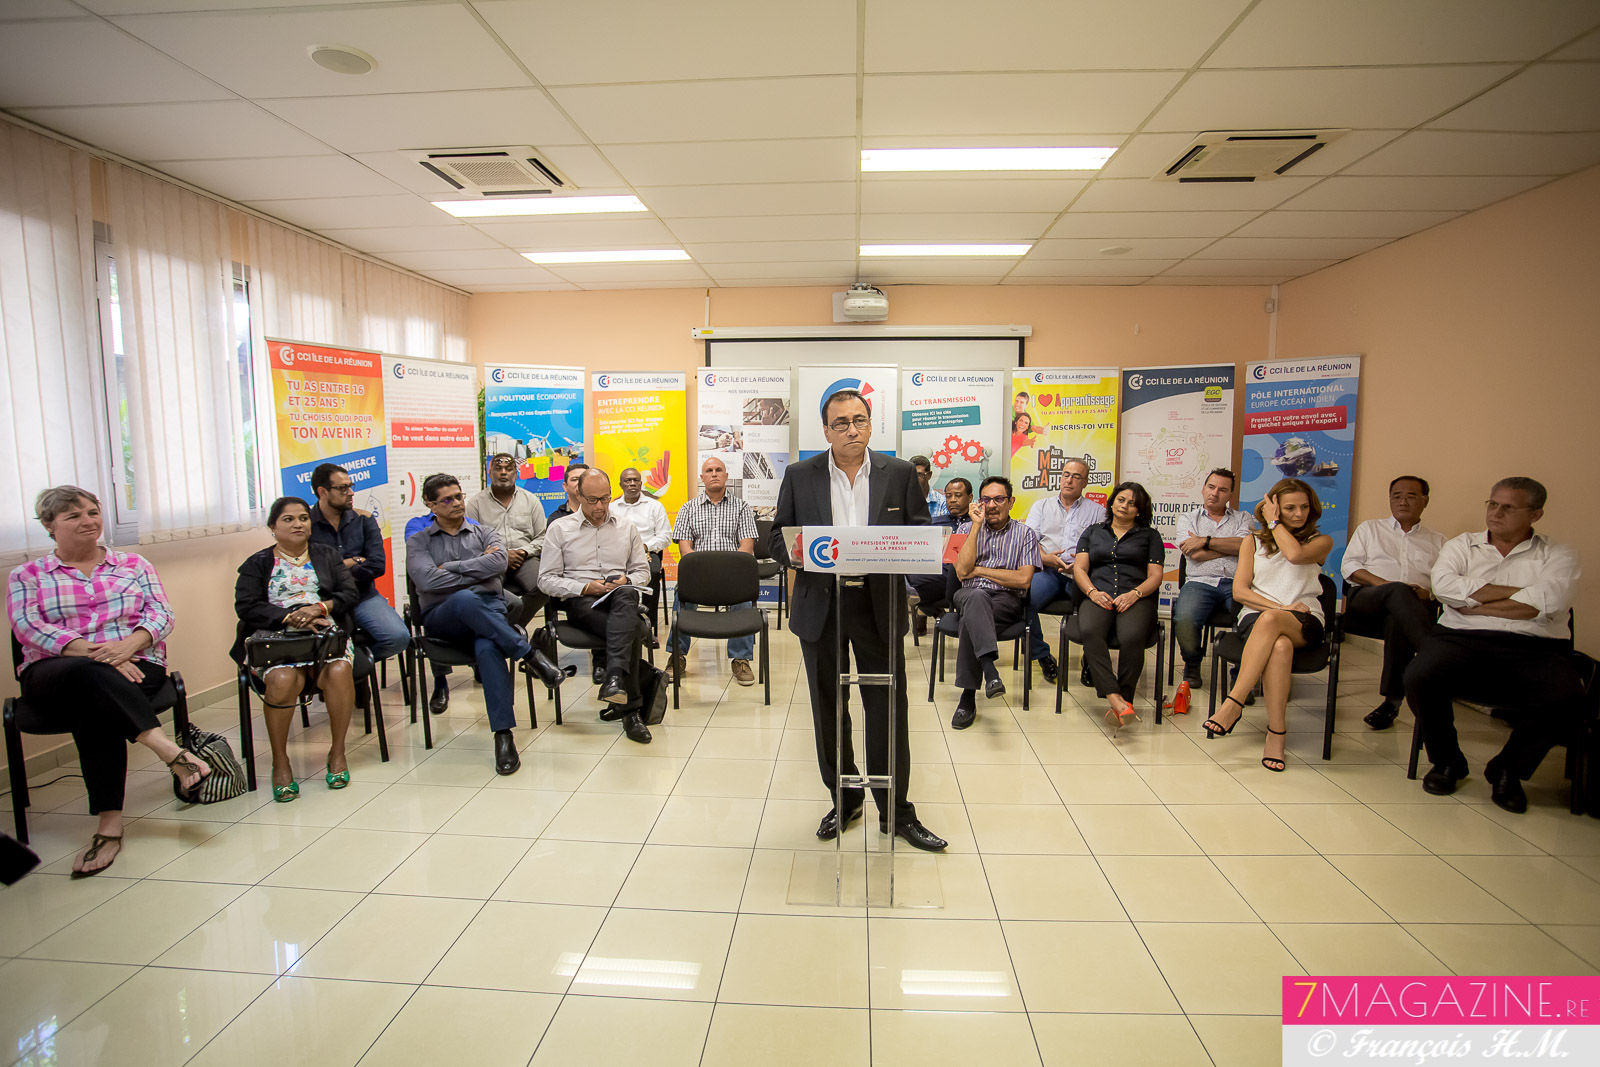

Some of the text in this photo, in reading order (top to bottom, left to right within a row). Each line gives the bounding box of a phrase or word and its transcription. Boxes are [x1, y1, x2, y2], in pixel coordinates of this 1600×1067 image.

[297, 352, 310, 360] CCI
[312, 353, 322, 362] ÎLE
[344, 358, 372, 368] RÉUNION
[287, 380, 364, 394] TU AS ENTRE 16
[1251, 384, 1345, 400] PÔLE INTERNATIONAL
[289, 396, 338, 407] ET 25 ANS
[597, 395, 660, 407] ENTREPRENDRE
[924, 396, 976, 404] TRANSMISSION
[1055, 393, 1115, 409] Apprentissage
[1251, 400, 1278, 408] EUROPE
[1281, 397, 1306, 406] OCÉAN
[291, 427, 362, 438] TON AVENIR
[1024, 478, 1033, 488] de
[1159, 503, 1180, 512] TOUR
